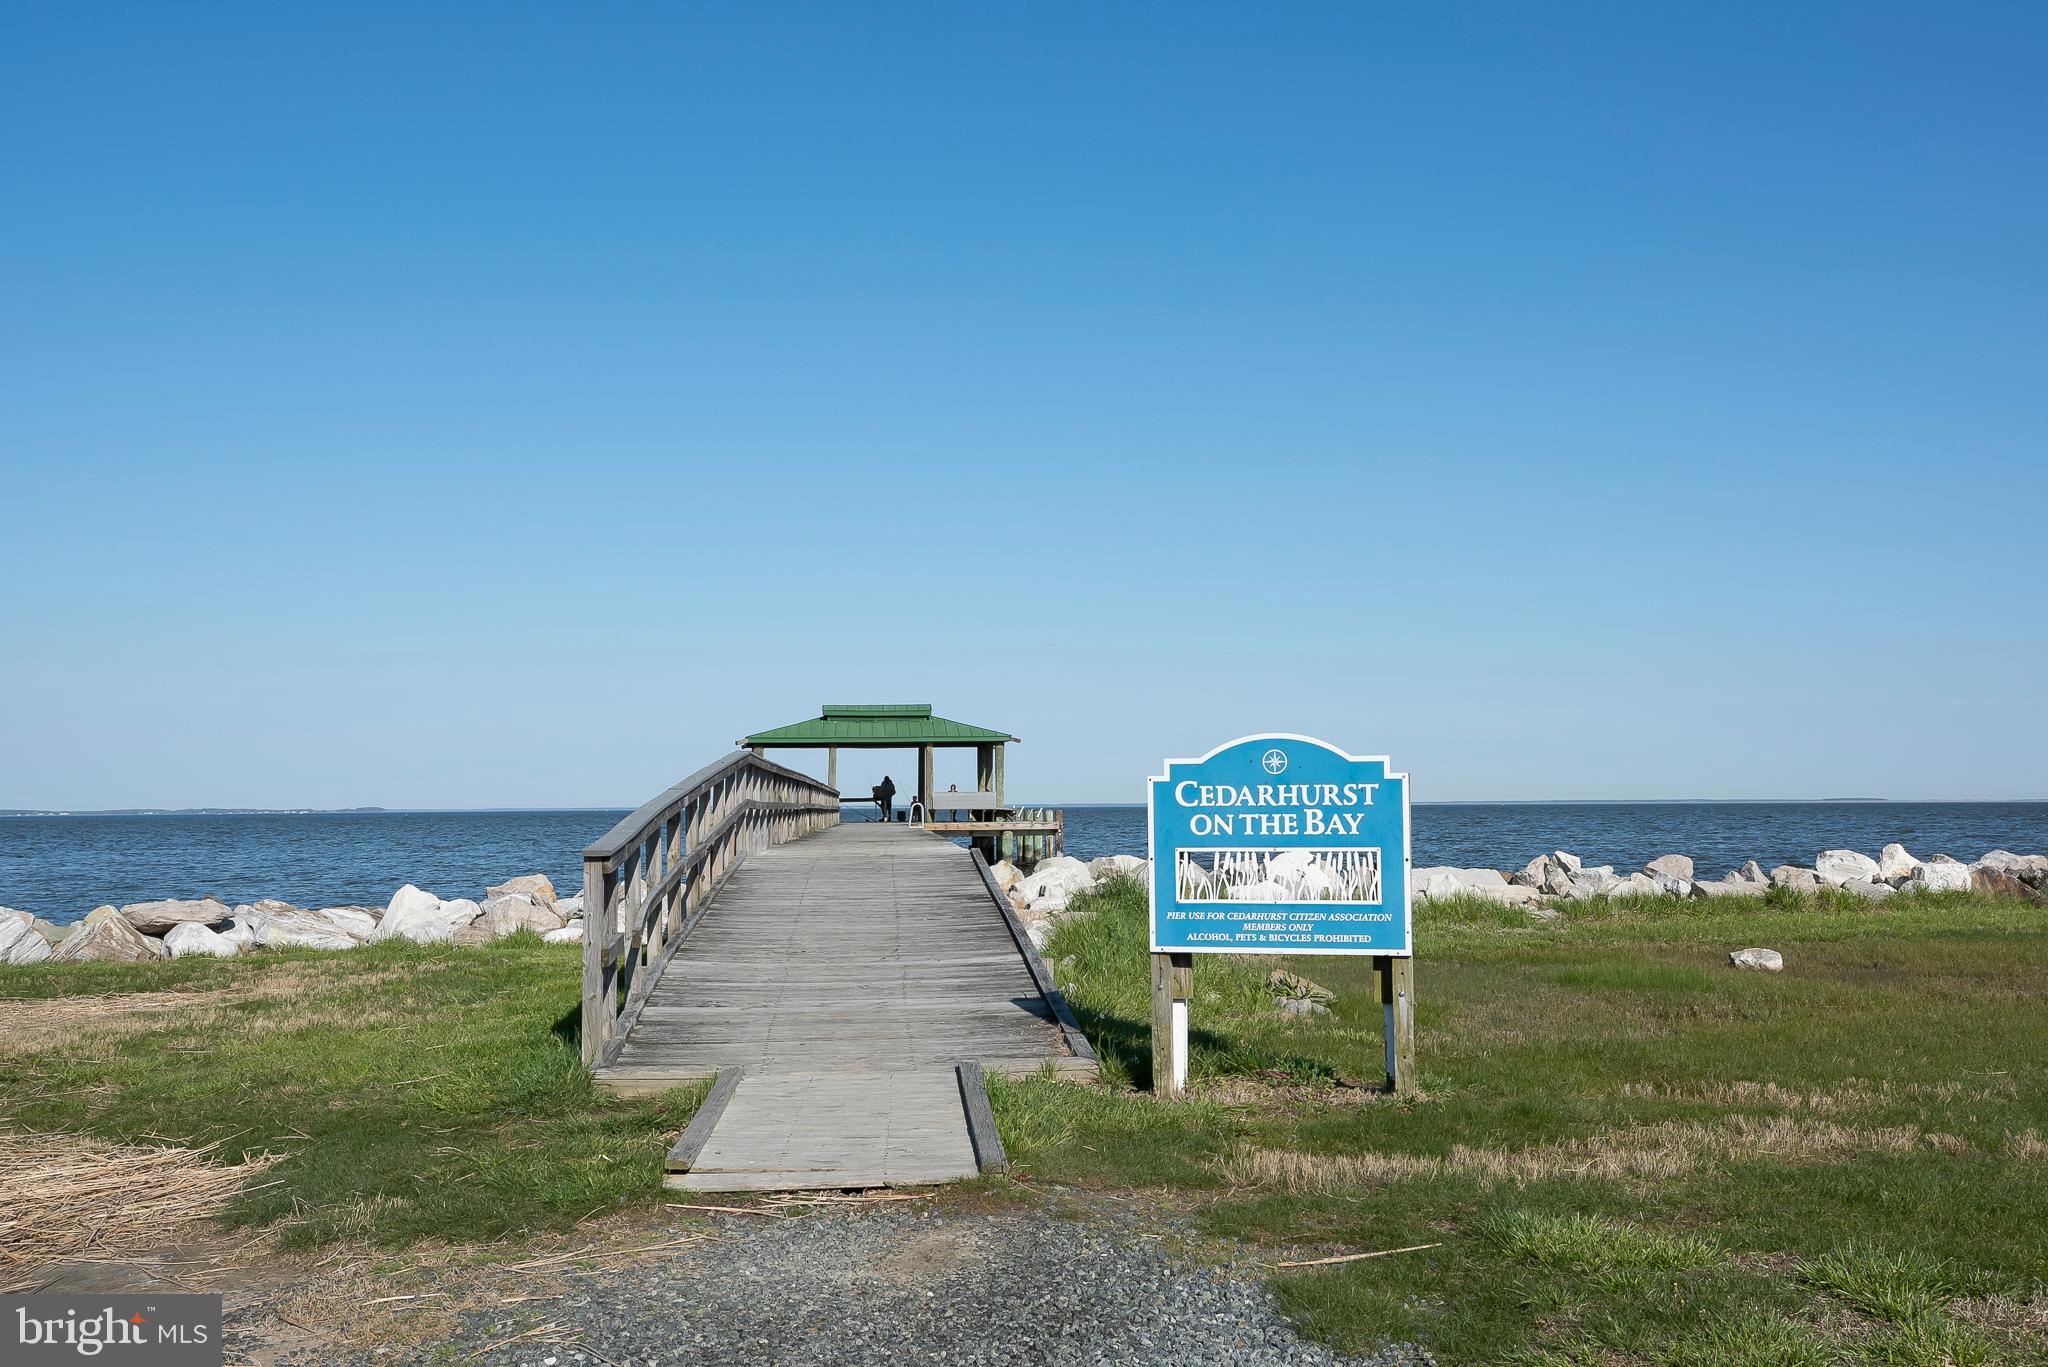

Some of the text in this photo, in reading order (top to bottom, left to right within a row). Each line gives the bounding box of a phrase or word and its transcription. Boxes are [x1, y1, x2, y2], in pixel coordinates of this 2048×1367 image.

[1175, 780, 1379, 807] CEDARHURST
[1190, 809, 1365, 836] ON THE BAY
[1166, 911, 1393, 922] PIER USE FOR CEDARHURST CITIZEN ASSOCIATION
[1242, 923, 1314, 932] MEMBERS ONLY
[1187, 933, 1372, 943] ALCOHOL, PETS & BICYCLES PROHIBITED
